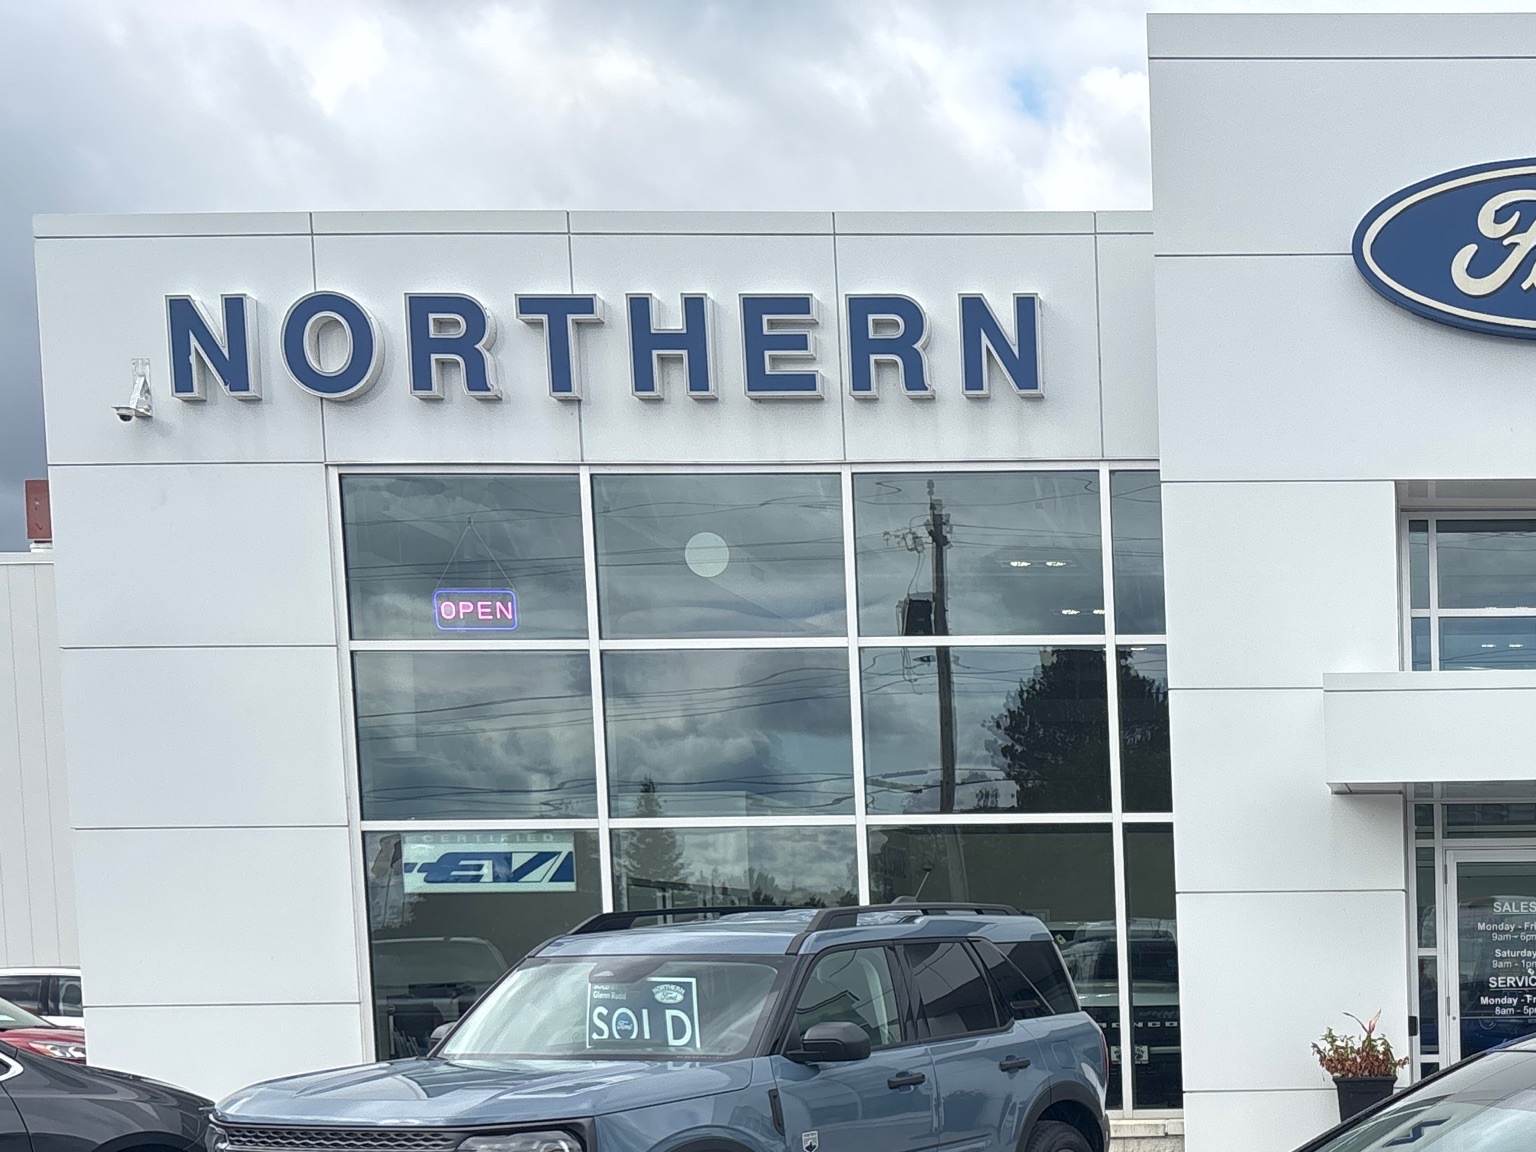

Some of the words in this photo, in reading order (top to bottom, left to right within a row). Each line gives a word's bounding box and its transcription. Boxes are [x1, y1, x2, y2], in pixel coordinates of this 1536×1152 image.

[165, 291, 1044, 401] NORTHERN
[440, 601, 513, 620] OPEN
[421, 833, 555, 843] CERTIFIED
[1477, 922, 1515, 932] Monday
[1492, 932, 1511, 941] 9am
[1492, 960, 1512, 968] 9am
[1480, 996, 1518, 1006] Monday
[1495, 1007, 1514, 1015] 8am
